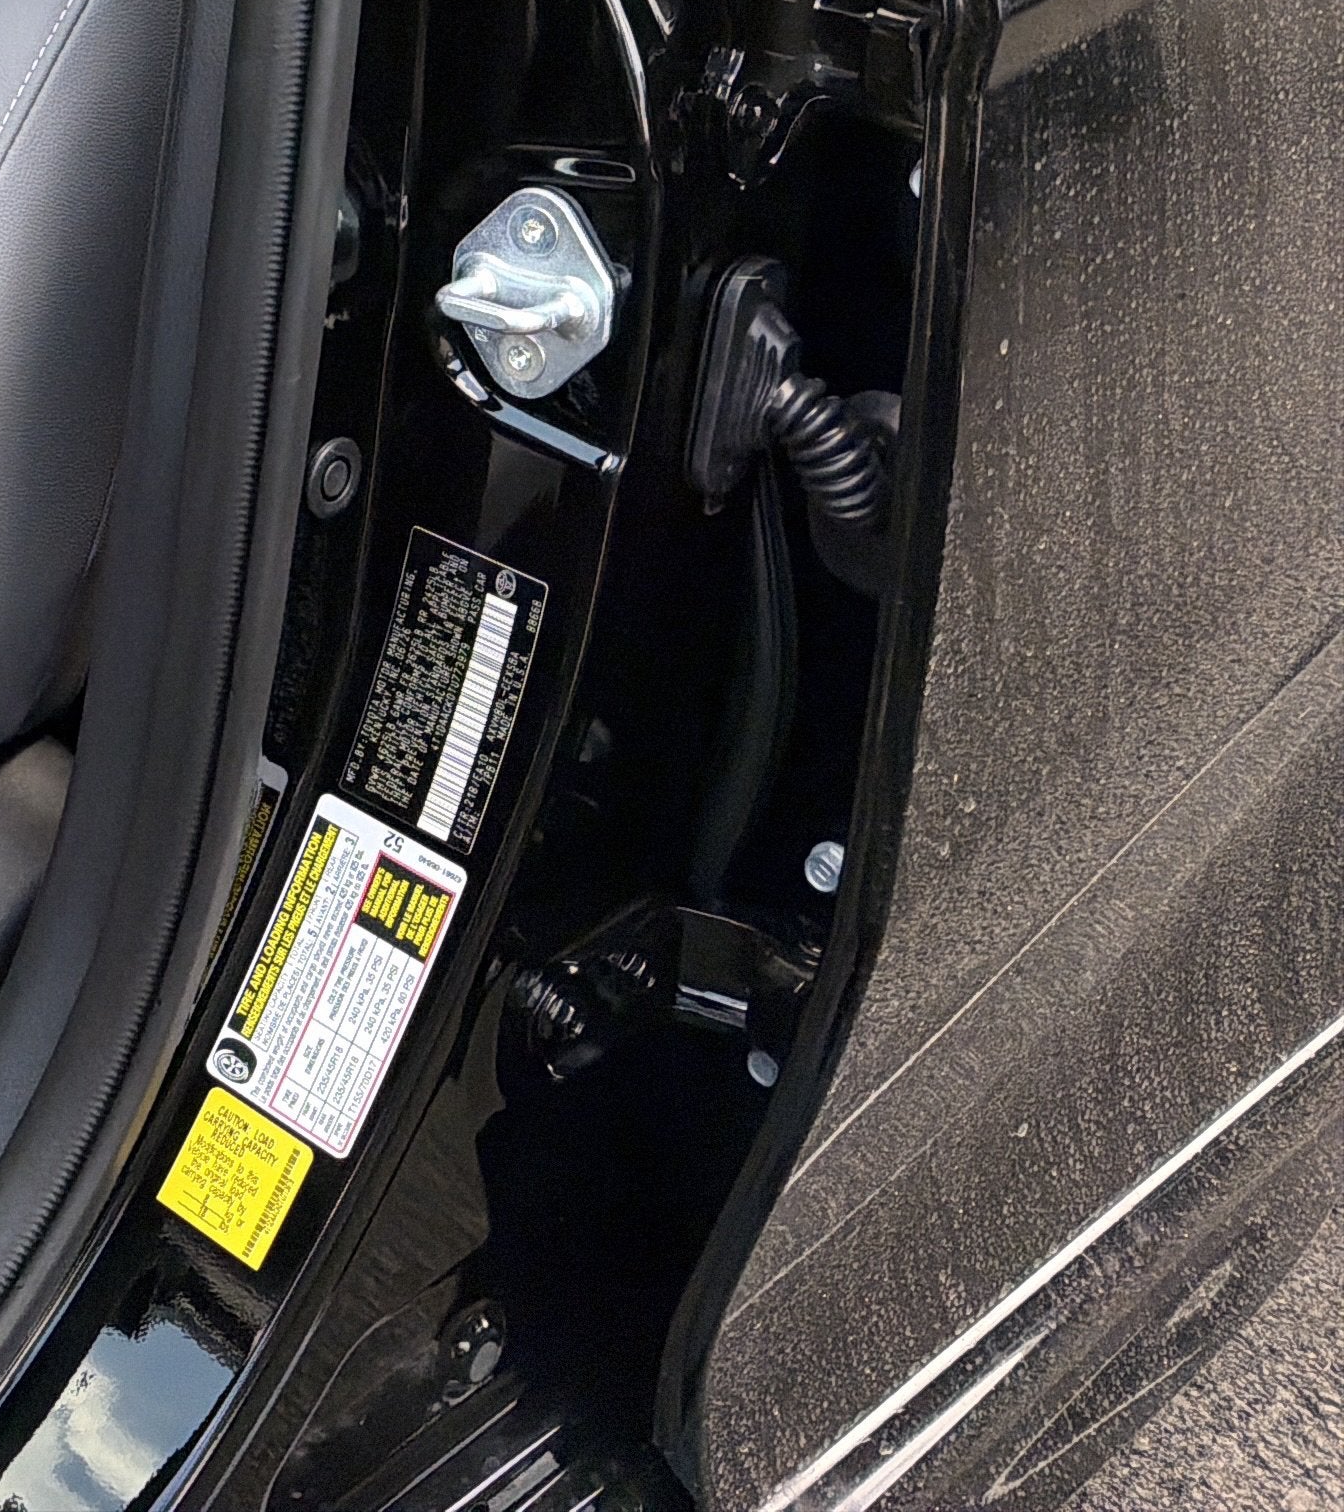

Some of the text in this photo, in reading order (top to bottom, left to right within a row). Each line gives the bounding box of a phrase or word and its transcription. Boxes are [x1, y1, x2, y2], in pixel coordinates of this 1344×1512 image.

[456, 557, 469, 573] ON
[398, 670, 411, 687] FR
[416, 607, 429, 625] RR
[398, 716, 417, 752] MOTOR
[446, 553, 460, 575] AND
[446, 624, 464, 659] SHOWN
[373, 658, 392, 696] MOTOR
[423, 661, 453, 736] MANUFACTURE
[495, 711, 513, 742] MADE
[504, 691, 518, 707] IN
[373, 767, 390, 798] THIS
[399, 661, 425, 717] CONFORMS
[417, 738, 430, 755] OF
[406, 756, 424, 787] DATE
[398, 787, 413, 811] THE
[381, 828, 406, 855] 52
[360, 865, 386, 914] SEE OWNER'S
[368, 870, 394, 918] MANUAL FOR
[235, 830, 323, 1019] TIRE AND LOADING INFORMATION
[240, 822, 339, 1040] RENSEIGNEMENTS SUR LES PNEUS ET LE CHARGEMENT
[276, 999, 286, 1012] DE
[281, 968, 300, 1001] PLACES
[306, 927, 318, 939] 5
[323, 884, 336, 896] 2
[343, 834, 356, 847] 3
[364, 970, 376, 986] 35
[369, 953, 384, 973] PSI
[385, 962, 400, 982] PSI
[379, 980, 392, 996] 35
[396, 989, 408, 1005] 60
[401, 972, 416, 992] PSI
[346, 1004, 361, 1025] 240
[362, 1014, 377, 1035] 240
[378, 1024, 393, 1046] 420
[315, 1043, 344, 1096] 235/45R18
[331, 1053, 360, 1106] 235/45R18
[347, 1057, 378, 1116] T155/70D17
[201, 1109, 279, 1168] CARRYING CAPACITY
[209, 1126, 247, 1159] REDUCED
[215, 1104, 276, 1151] CAUTION: LOAD
